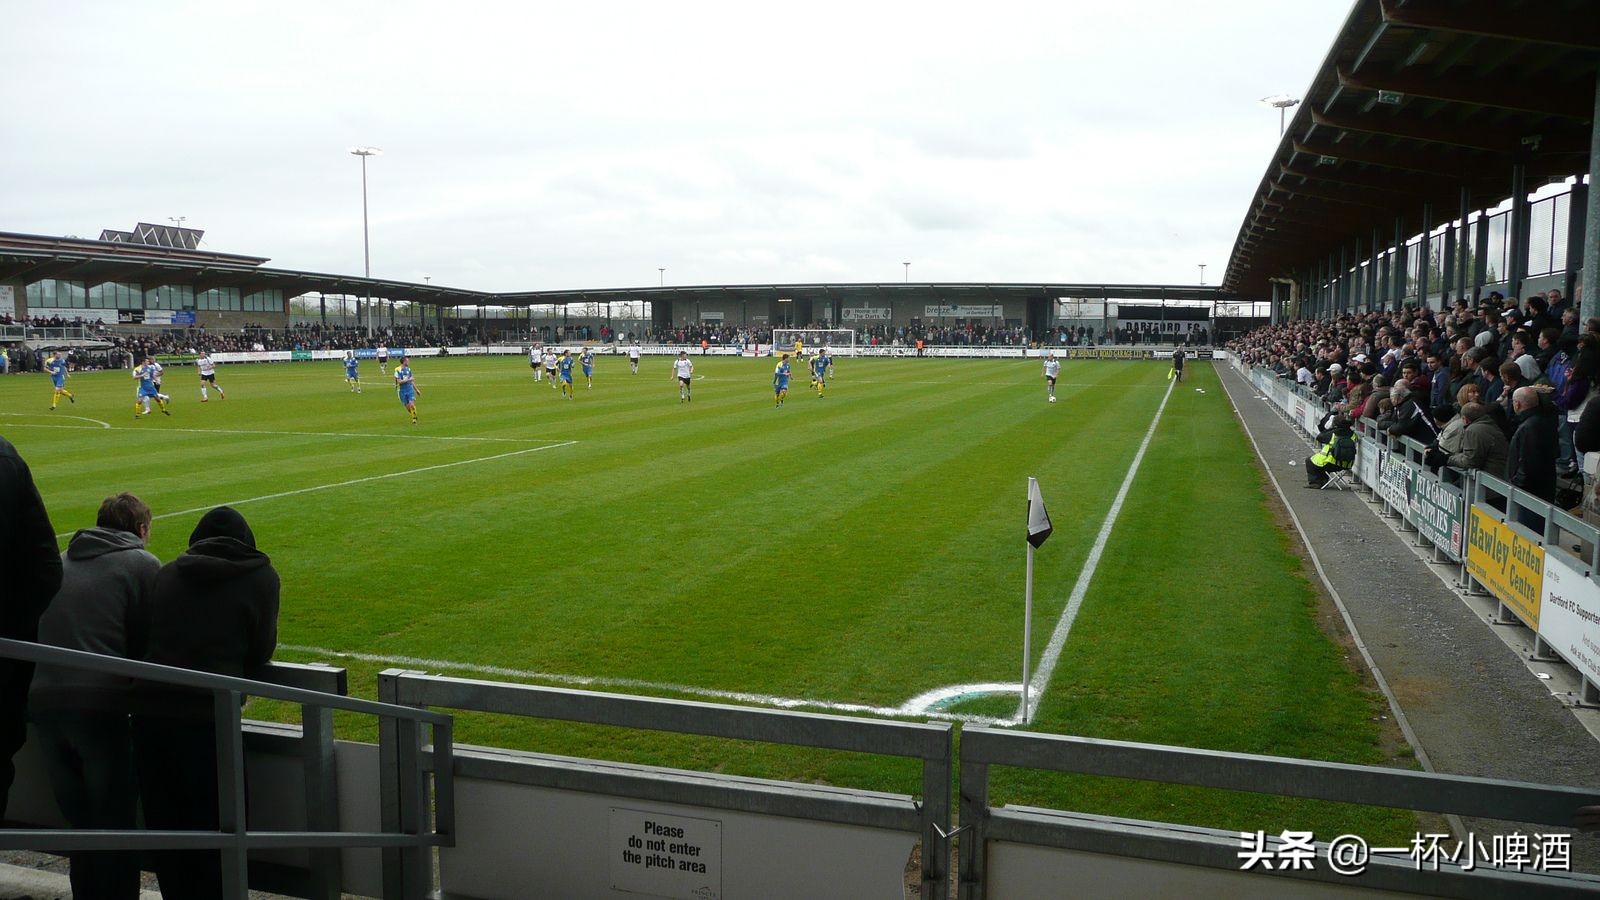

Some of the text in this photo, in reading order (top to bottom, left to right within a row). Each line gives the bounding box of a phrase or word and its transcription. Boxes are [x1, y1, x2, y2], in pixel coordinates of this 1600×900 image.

[1421, 498, 1449, 534] SUPPLIES
[1431, 484, 1458, 517] GARDEN
[1470, 513, 1509, 575] Hawley
[1512, 534, 1541, 575] Garden
[1509, 564, 1536, 605] Centre
[1549, 592, 1569, 610] Dartford
[1568, 600, 1576, 613] FC
[628, 834, 701, 857] do not enter
[644, 820, 685, 839] Please
[622, 849, 707, 874] the pitch area
